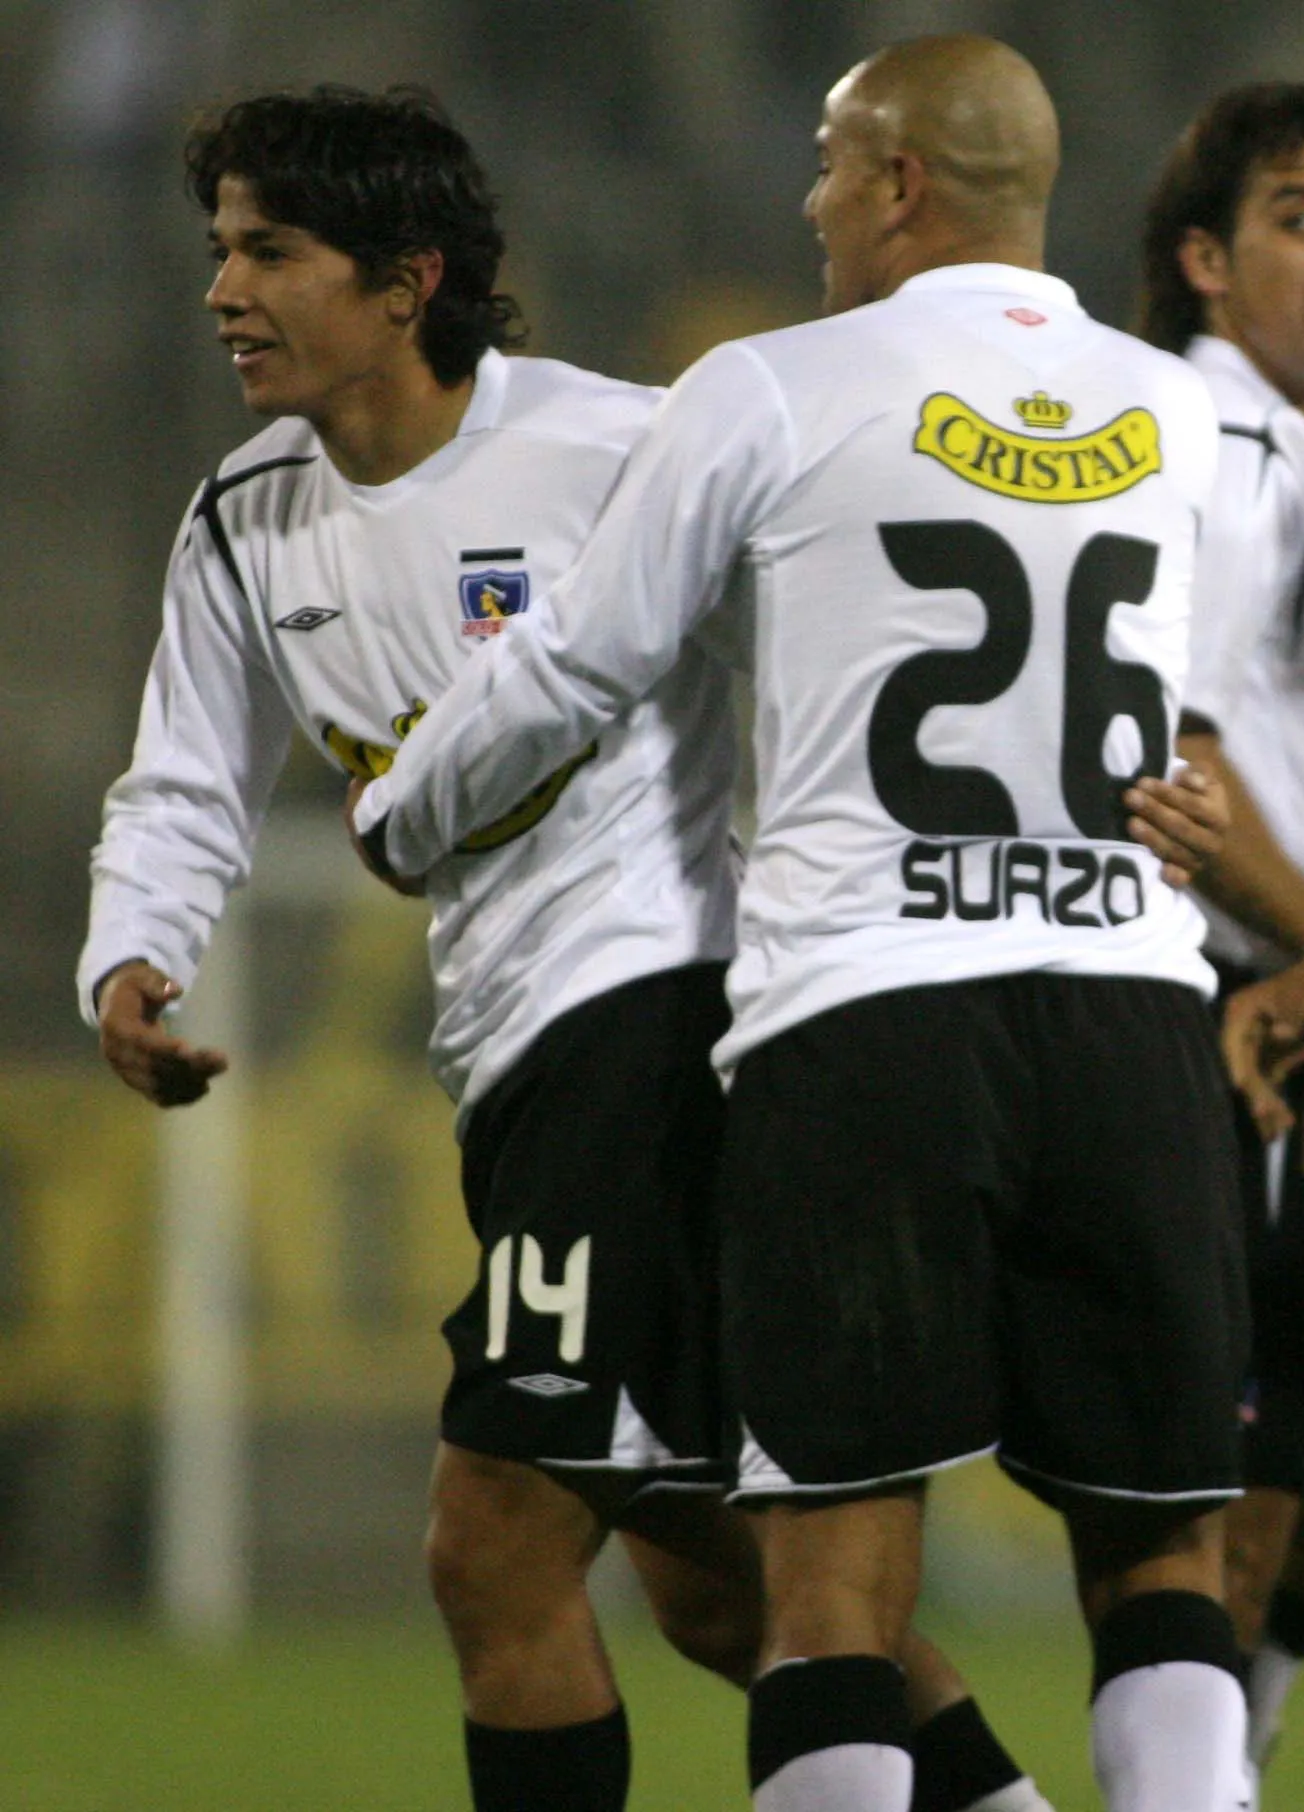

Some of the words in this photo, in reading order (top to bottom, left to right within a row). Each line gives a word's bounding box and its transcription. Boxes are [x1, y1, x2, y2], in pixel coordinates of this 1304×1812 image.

[937, 414, 1147, 489] CRISTAL
[867, 519, 1168, 840] 26
[898, 840, 1144, 927] SUAZO
[485, 1233, 591, 1363] 14
